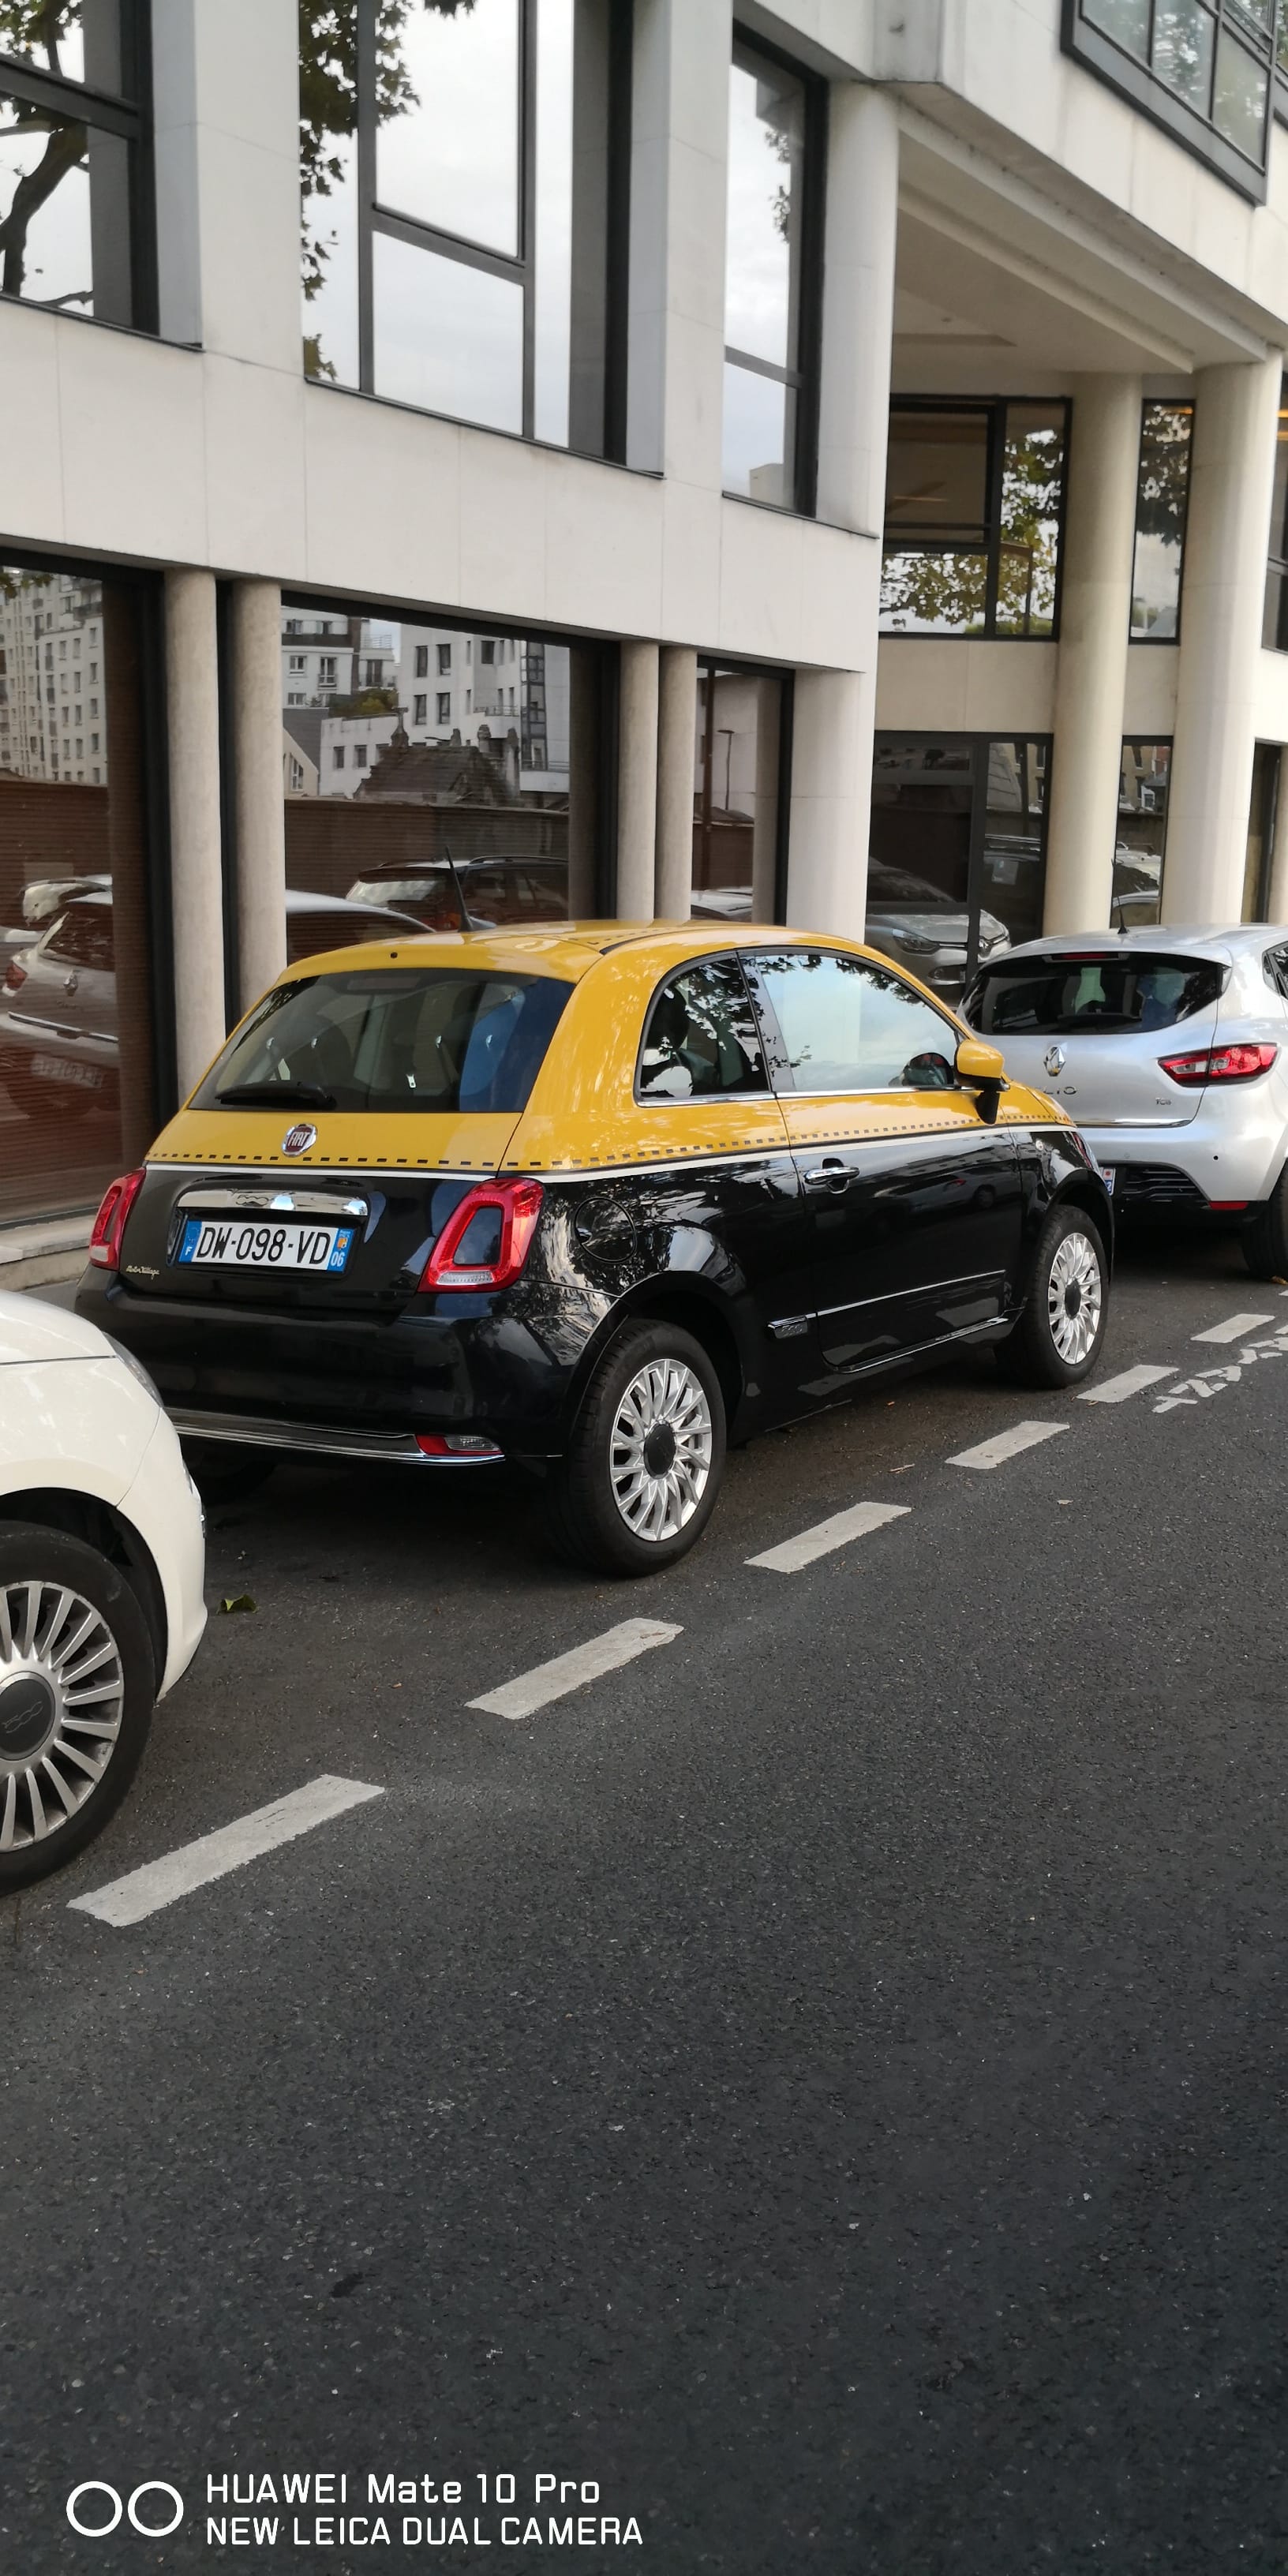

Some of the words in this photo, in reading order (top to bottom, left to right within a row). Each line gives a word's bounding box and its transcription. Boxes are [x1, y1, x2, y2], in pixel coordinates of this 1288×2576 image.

[1035, 1085, 1077, 1095] LIO
[287, 1131, 311, 1147] FIAT
[197, 1226, 331, 1264] DW-098-VD
[330, 1251, 346, 1267] 06
[1151, 1324, 1288, 1413] AYANT
